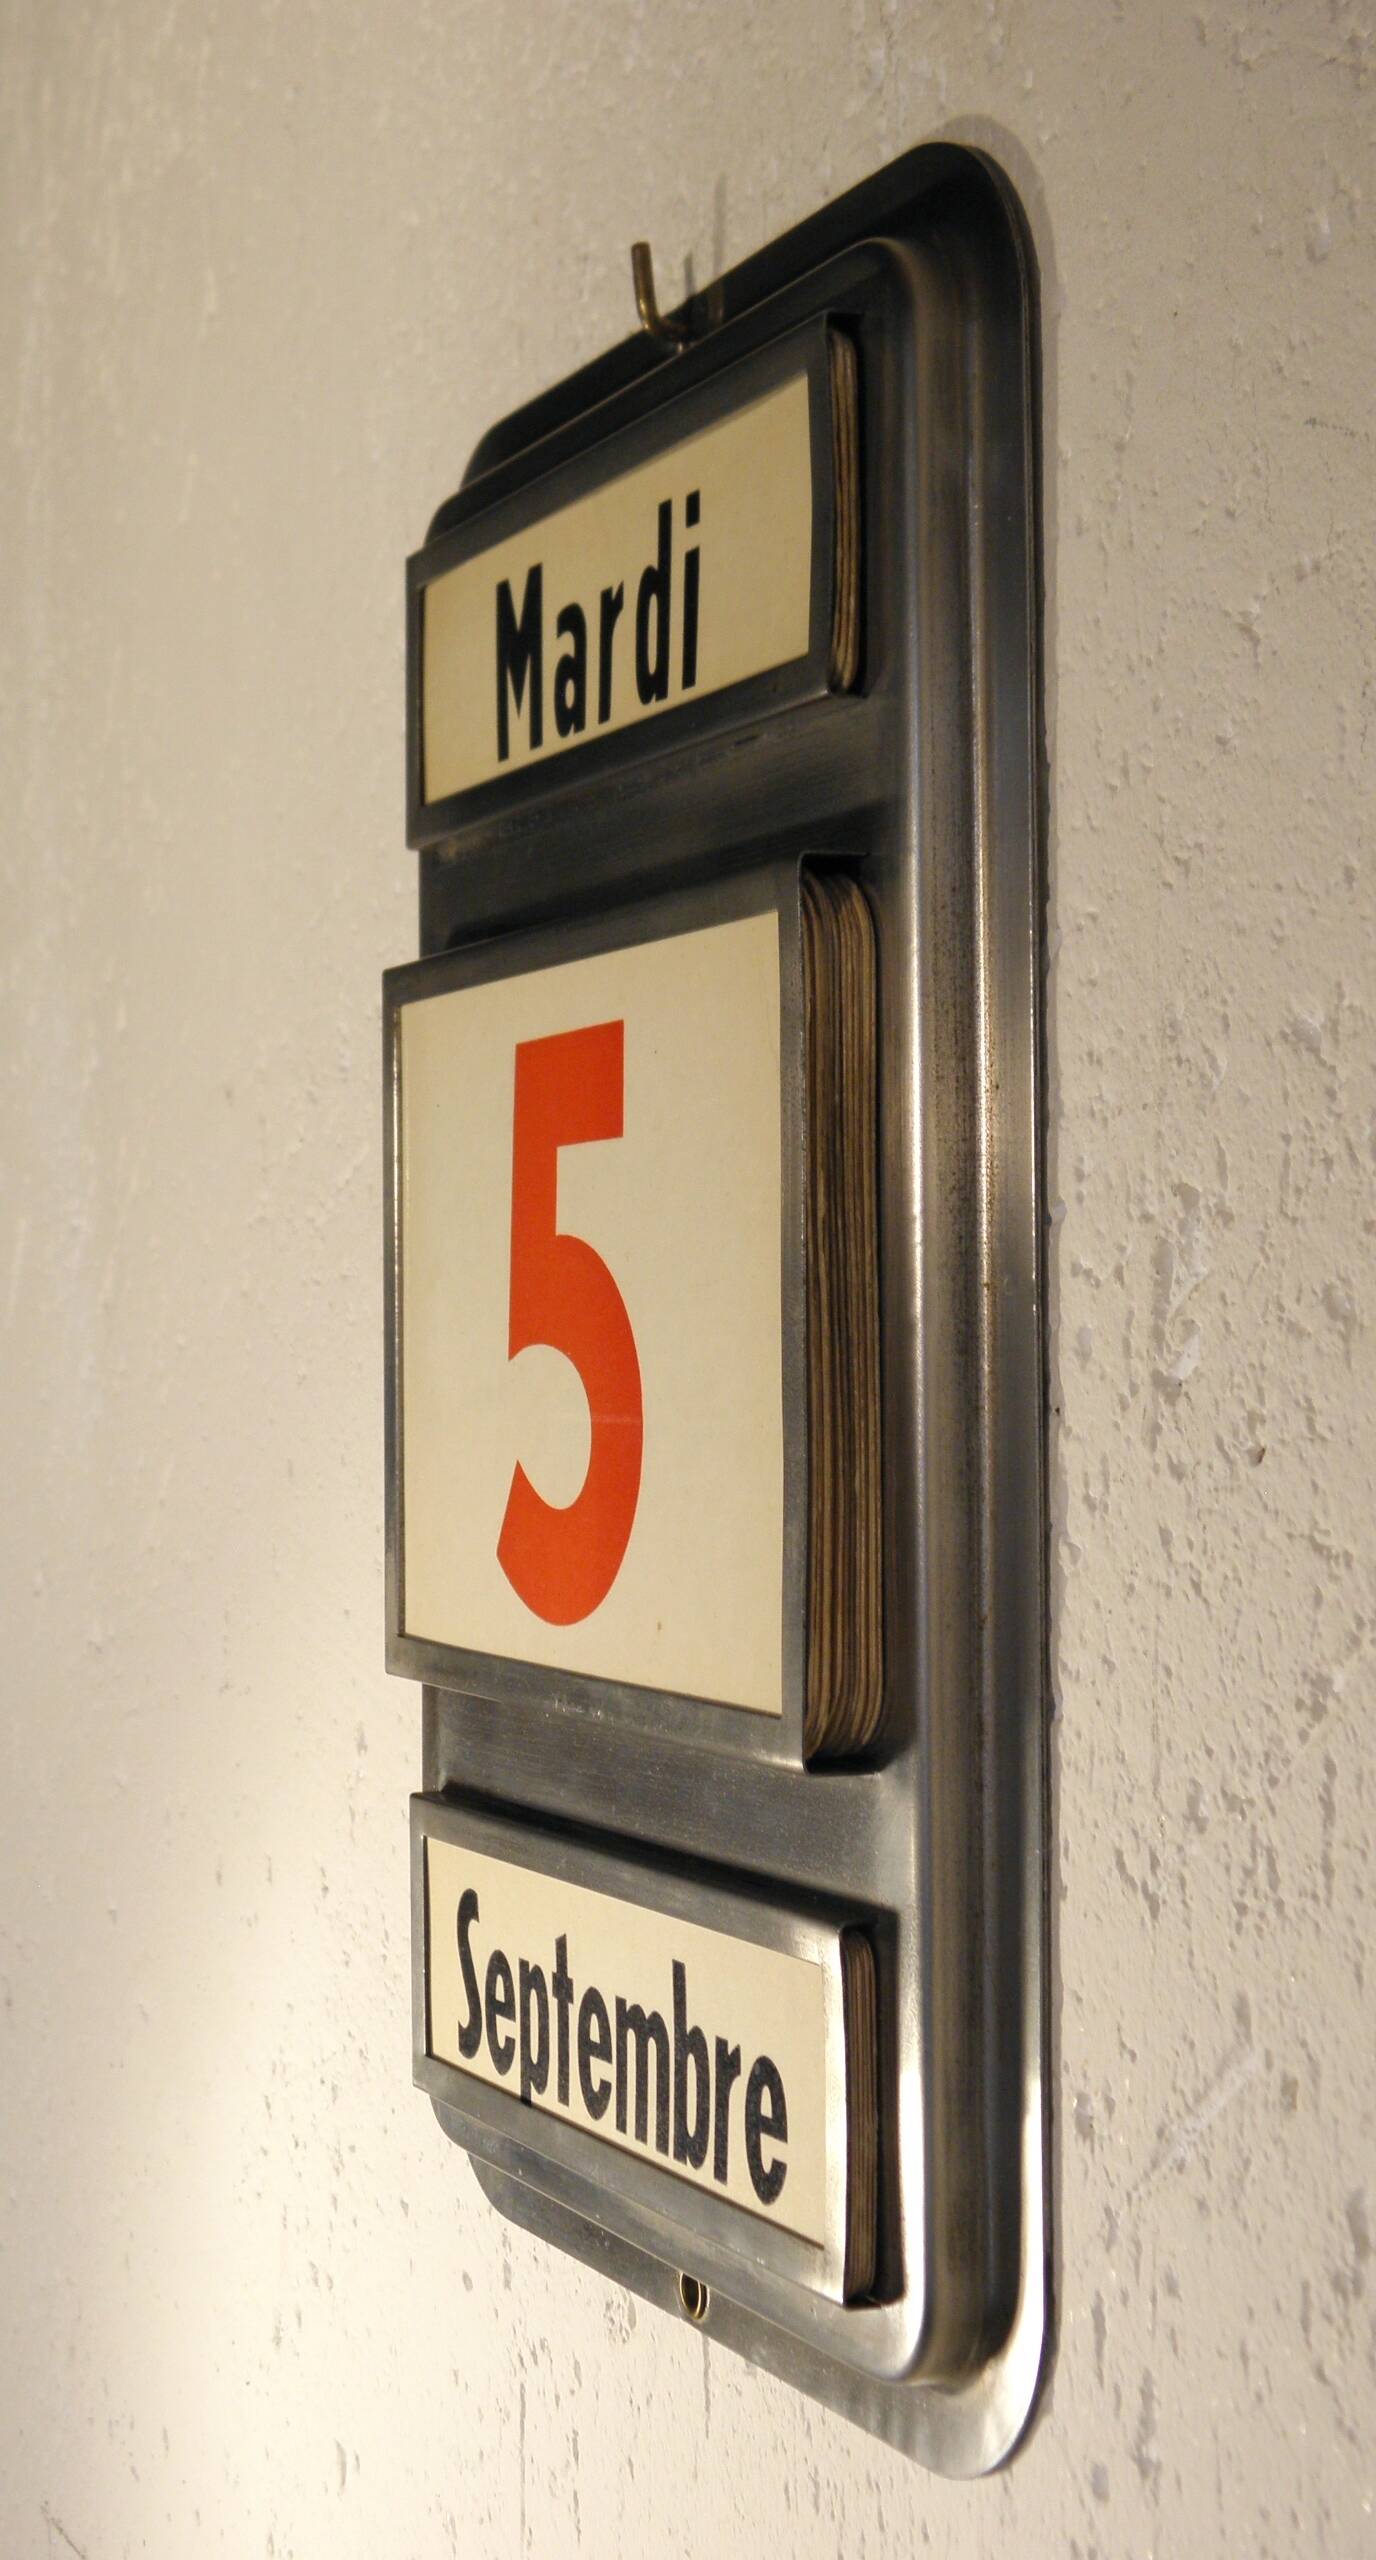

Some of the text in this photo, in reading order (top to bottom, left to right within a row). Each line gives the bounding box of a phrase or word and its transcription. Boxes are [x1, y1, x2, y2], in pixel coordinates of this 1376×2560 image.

[496, 489, 701, 762] Mardi
[496, 1020, 644, 1626] 5
[456, 1888, 788, 2205] Septembre
